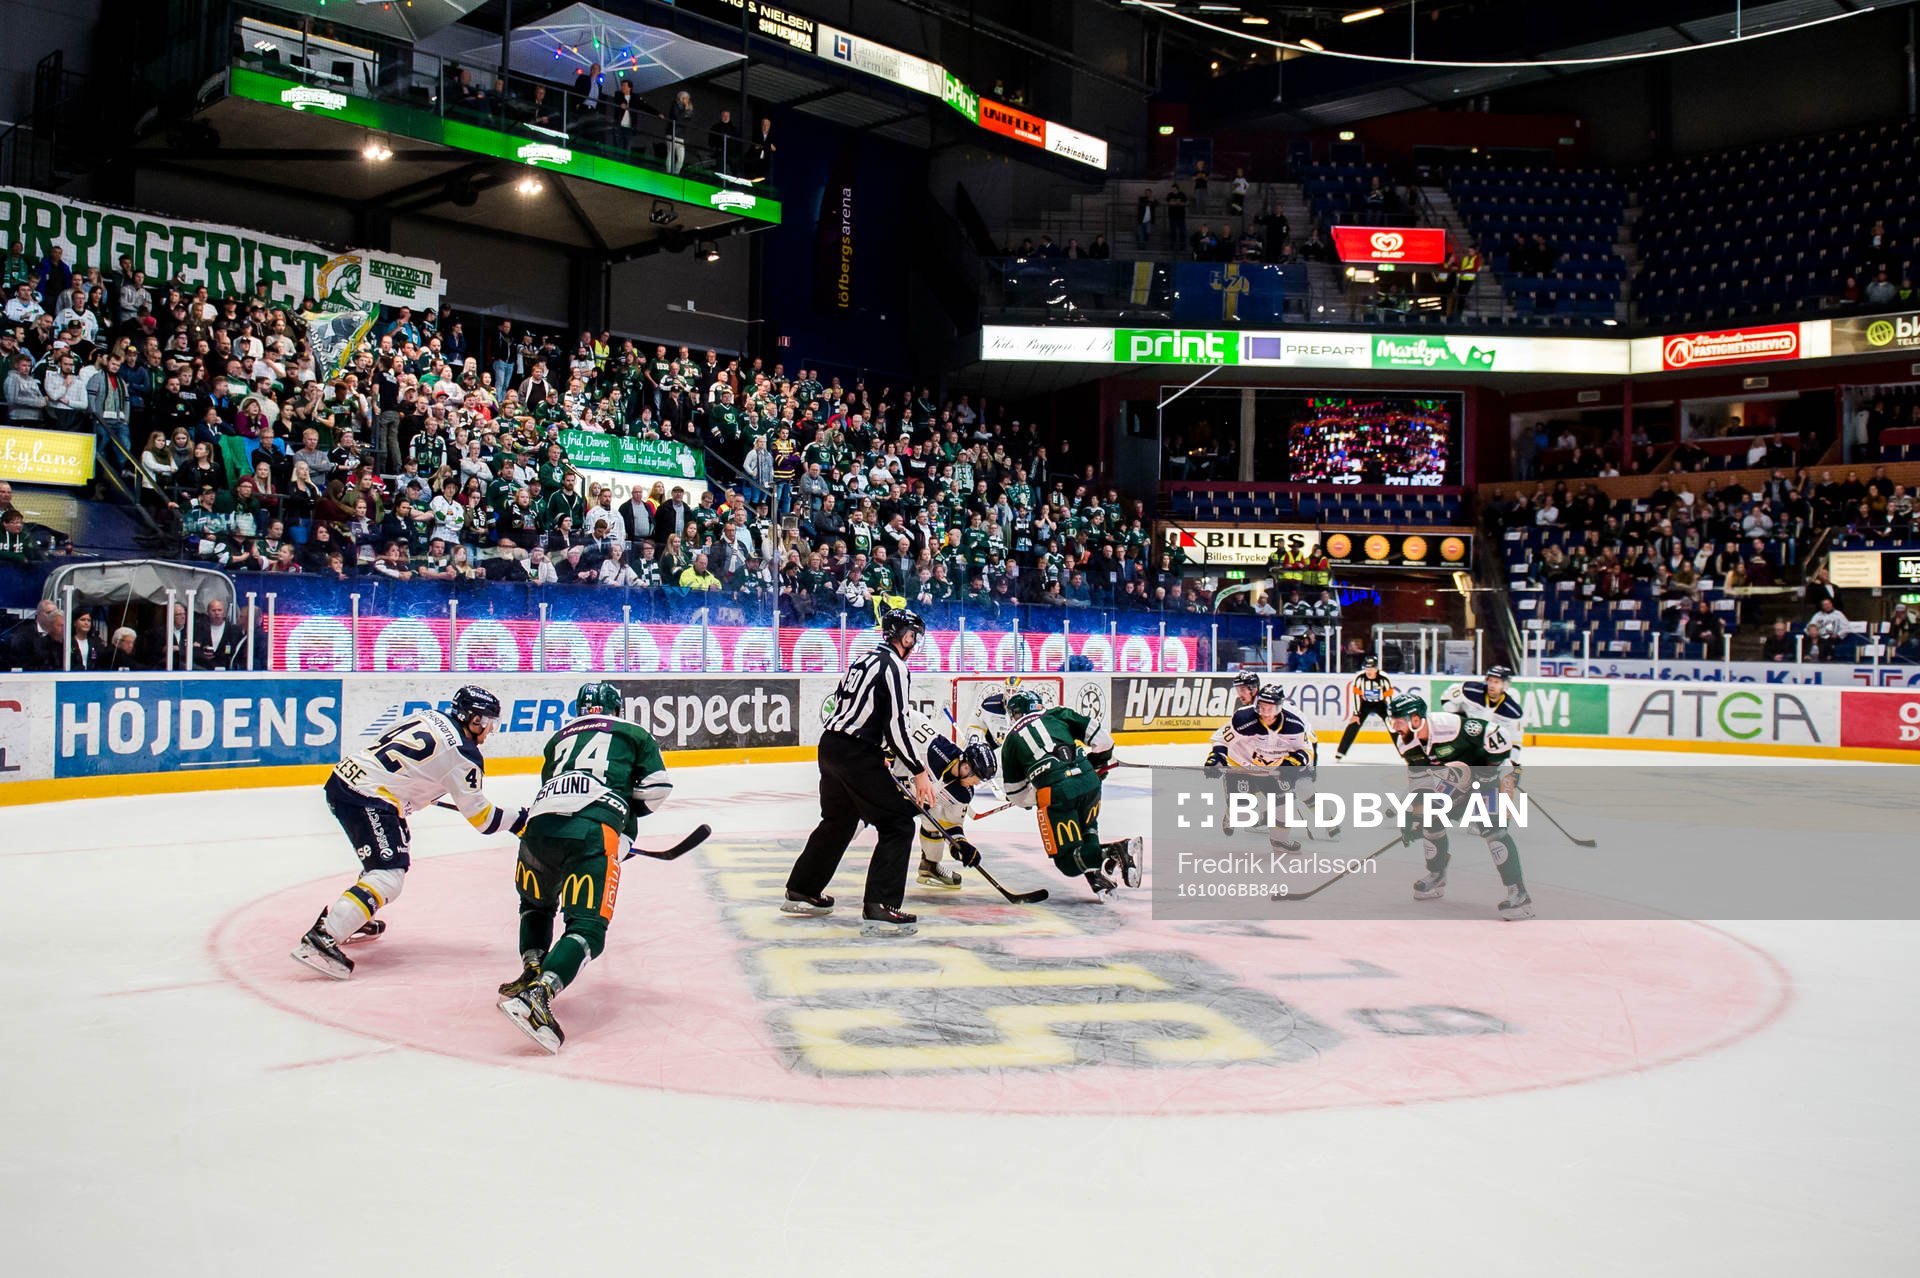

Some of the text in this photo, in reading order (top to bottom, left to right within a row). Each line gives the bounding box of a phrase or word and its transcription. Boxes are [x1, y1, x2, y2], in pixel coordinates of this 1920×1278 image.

[760, 5, 813, 33] NIELSEN
[984, 107, 1042, 135] UNIFLEX
[1131, 330, 1225, 361] print
[1286, 345, 1367, 356] PREPART
[1377, 339, 1448, 366] Marilyn
[0, 437, 81, 474] kylane
[1206, 552, 1233, 562] Billes
[1207, 532, 1305, 549] BILLES
[62, 687, 338, 758] HÖJDENS
[617, 686, 792, 746] nspecta
[1512, 688, 1572, 729] AY!
[1628, 689, 1821, 744] ATEA
[367, 720, 438, 774] 42
[1018, 718, 1057, 761] 11
